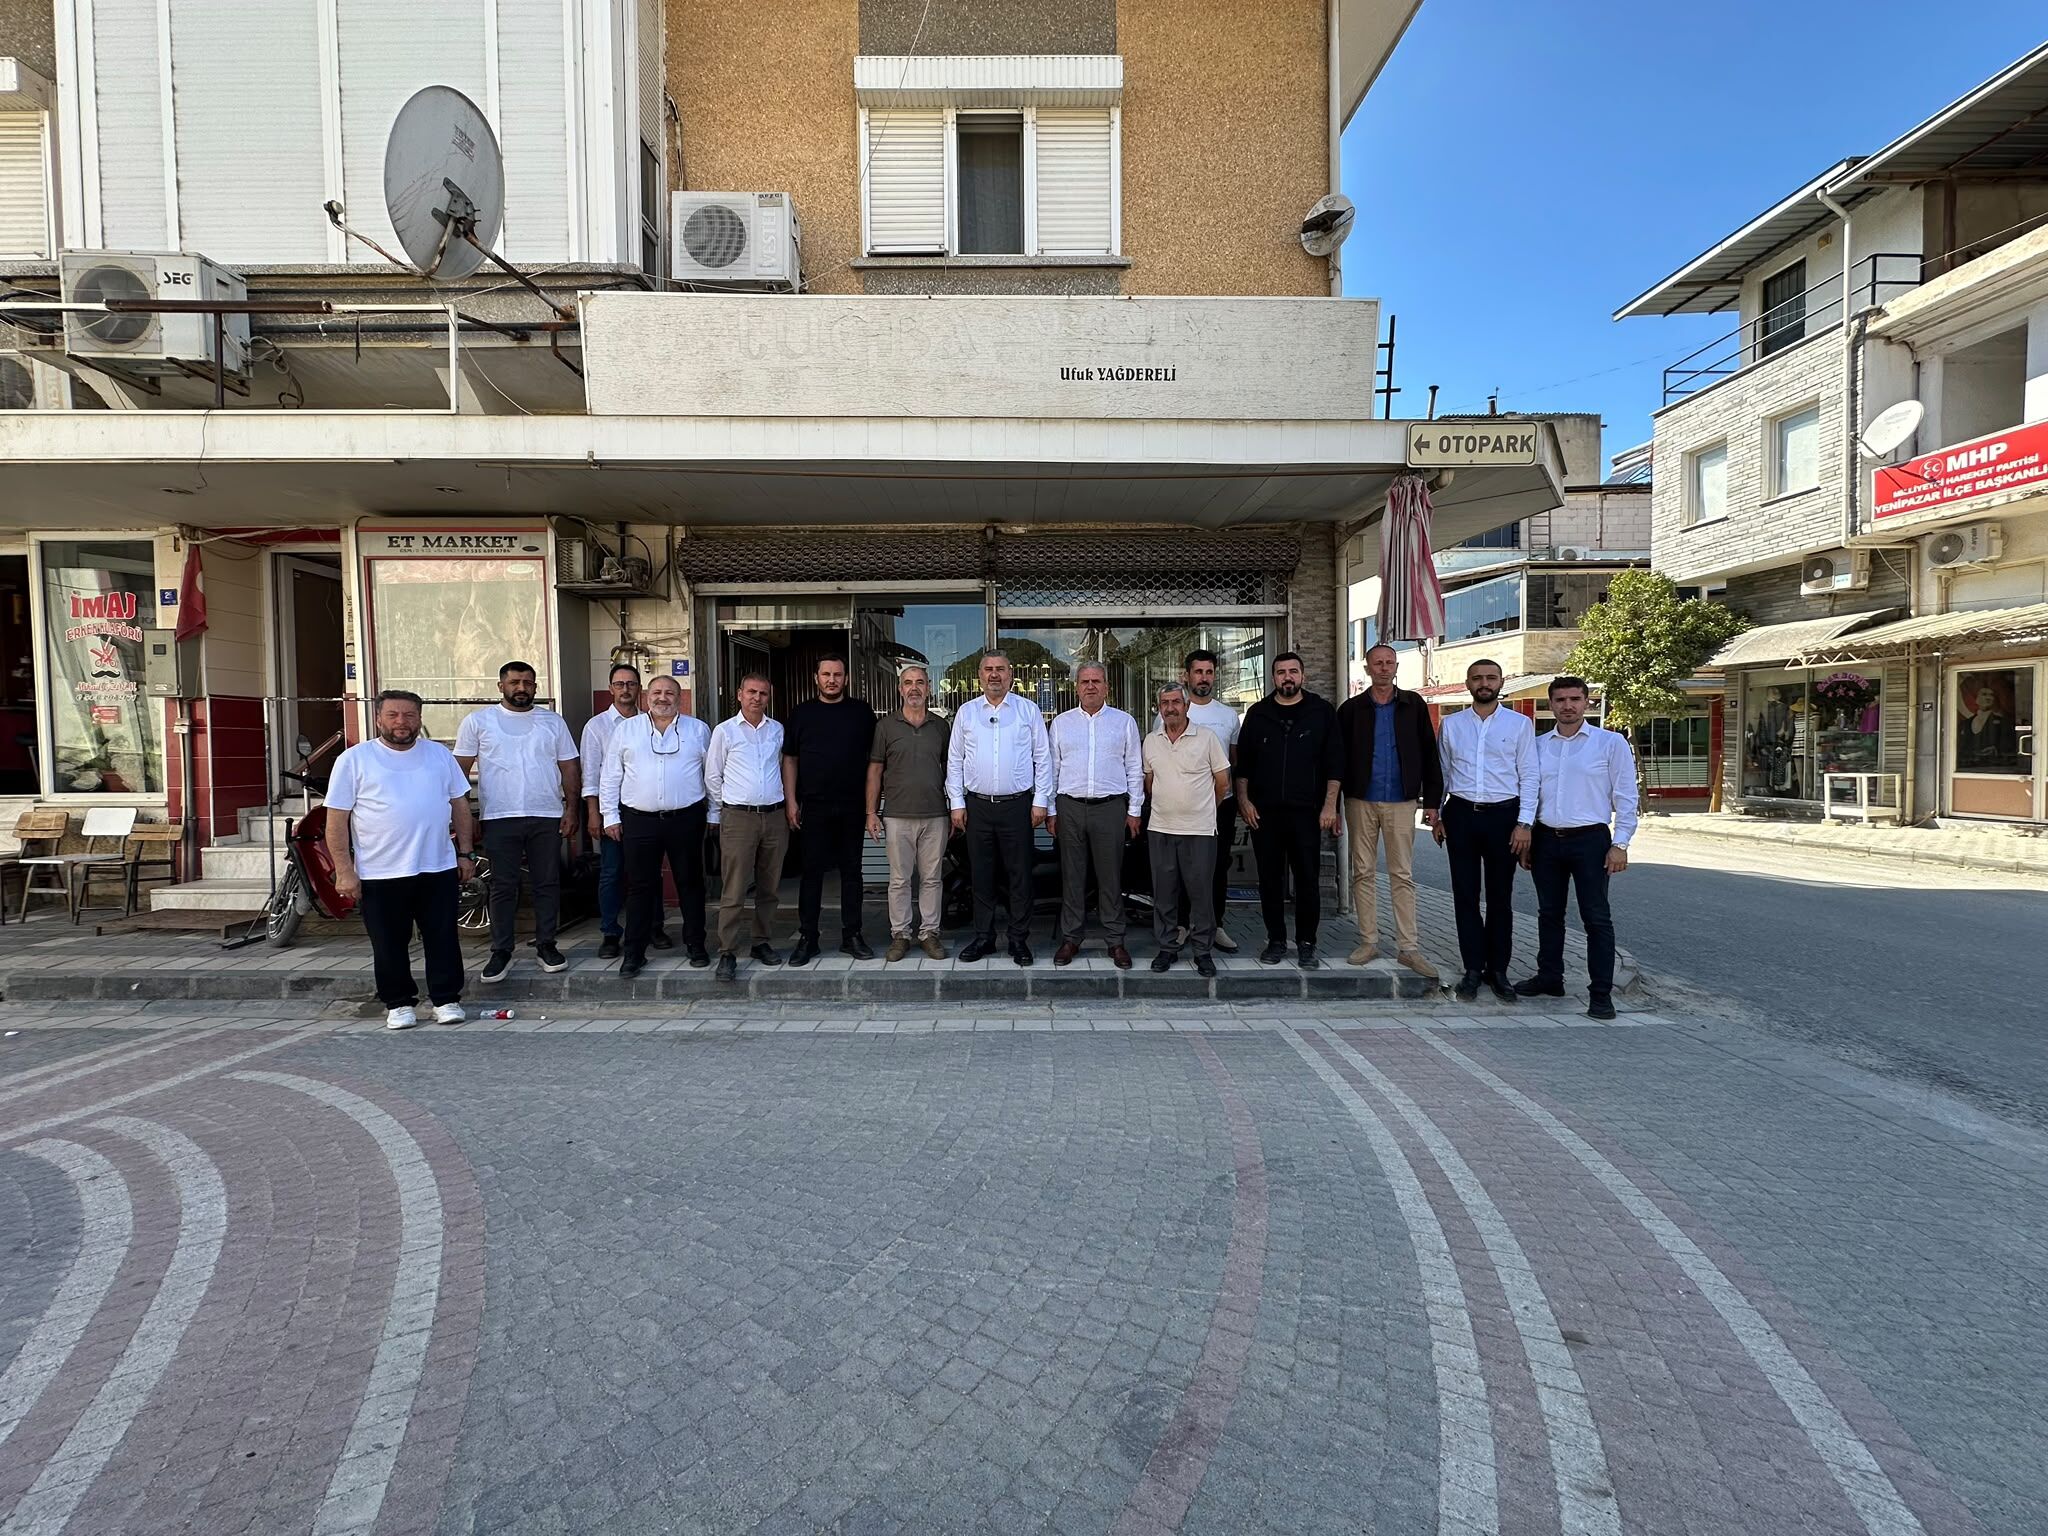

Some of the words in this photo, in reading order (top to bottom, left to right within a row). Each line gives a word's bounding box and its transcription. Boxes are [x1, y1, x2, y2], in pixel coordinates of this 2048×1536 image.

[163, 271, 194, 285] SEG
[1060, 367, 1093, 381] Ufuk
[1097, 364, 1177, 381] YAĞDERELİ
[1438, 434, 1534, 454] OTOPARK
[1946, 442, 2008, 473] MHP
[1945, 467, 1994, 485] HAREKET
[1996, 453, 2040, 472] PARTİSİ
[1874, 490, 1942, 514] YENİPAZAR
[1943, 483, 1973, 498] İLÇE
[387, 536, 415, 548] ET
[422, 536, 518, 548] MARKET
[70, 590, 137, 620] İMAJ
[65, 622, 100, 643] ERKEK
[100, 621, 143, 643] KUAFÖRÜ
